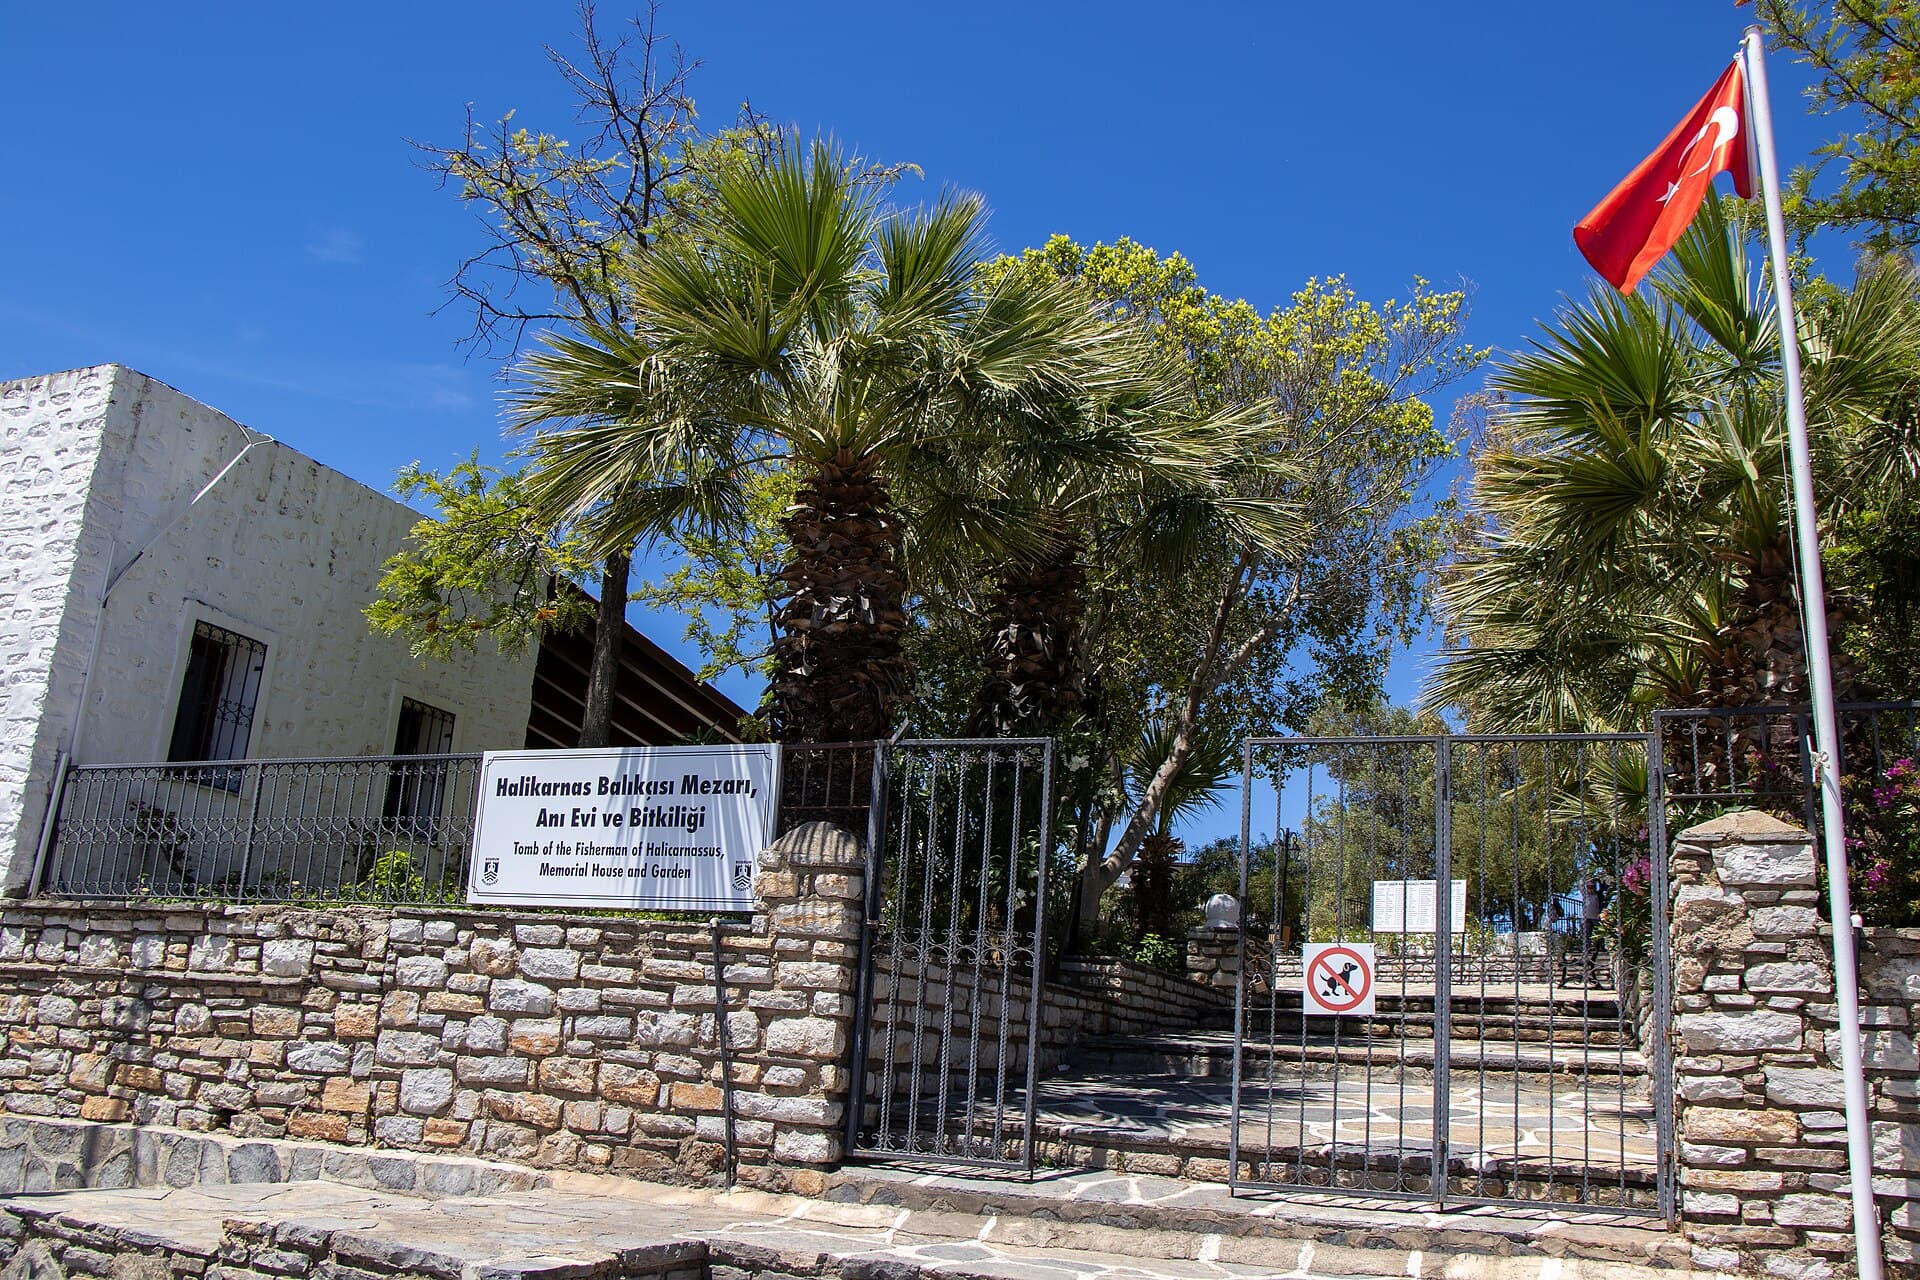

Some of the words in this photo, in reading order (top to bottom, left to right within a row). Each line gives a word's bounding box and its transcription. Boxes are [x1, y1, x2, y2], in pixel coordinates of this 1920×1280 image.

[496, 775, 592, 797] Halikarnas
[597, 774, 675, 801] Balıkçısı
[680, 775, 758, 799] Mezarı,
[535, 808, 566, 828] Anı
[570, 806, 597, 828] Evi
[602, 813, 624, 828] ve
[629, 806, 706, 834] Bitkiliği
[513, 841, 539, 856] Tomb
[542, 840, 554, 856] of
[556, 840, 572, 856] the
[575, 840, 628, 857] Fisherman
[631, 841, 643, 857] of
[646, 841, 725, 860] Halicarnassus,
[539, 862, 589, 877] Memorial
[591, 863, 624, 878] House
[627, 863, 648, 878] and
[651, 863, 691, 879] Garden
